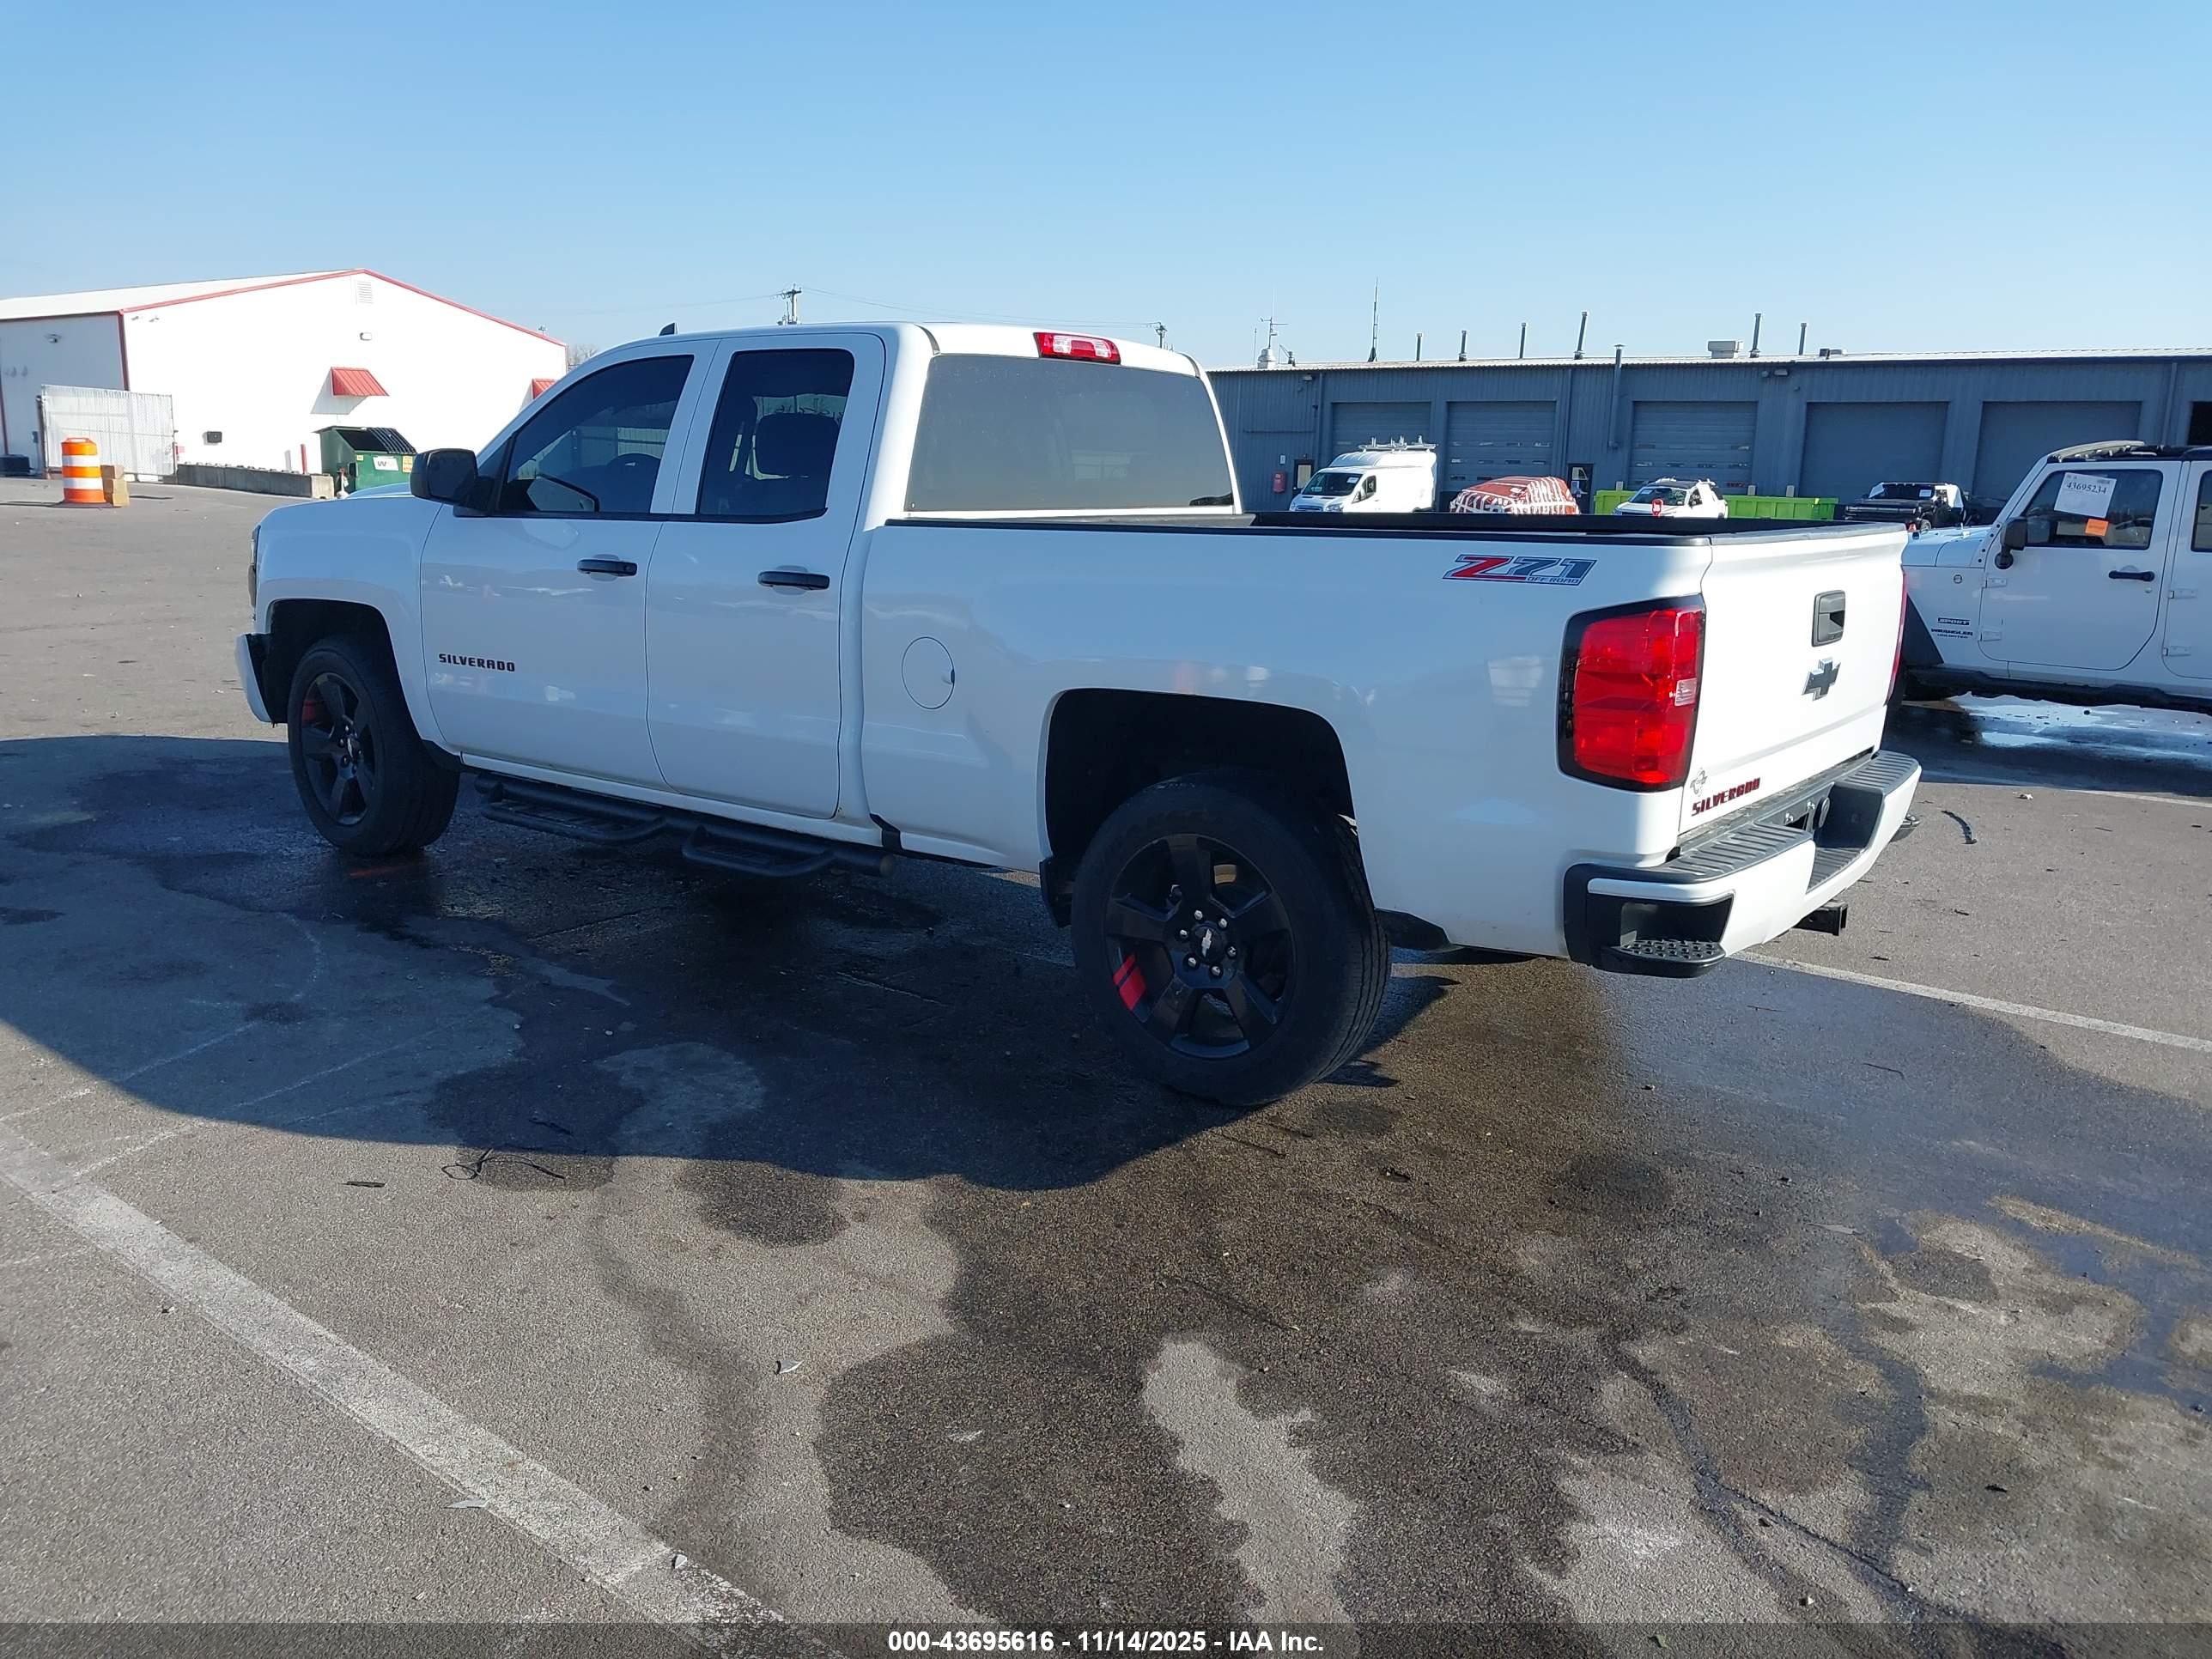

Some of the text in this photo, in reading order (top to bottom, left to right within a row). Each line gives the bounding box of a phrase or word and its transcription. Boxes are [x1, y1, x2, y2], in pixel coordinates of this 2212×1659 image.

[2066, 482, 2107, 494] 43695234
[1443, 554, 1597, 586] Z71
[438, 653, 515, 672] SILVERADO
[1691, 777, 1760, 817] SILVERADO
